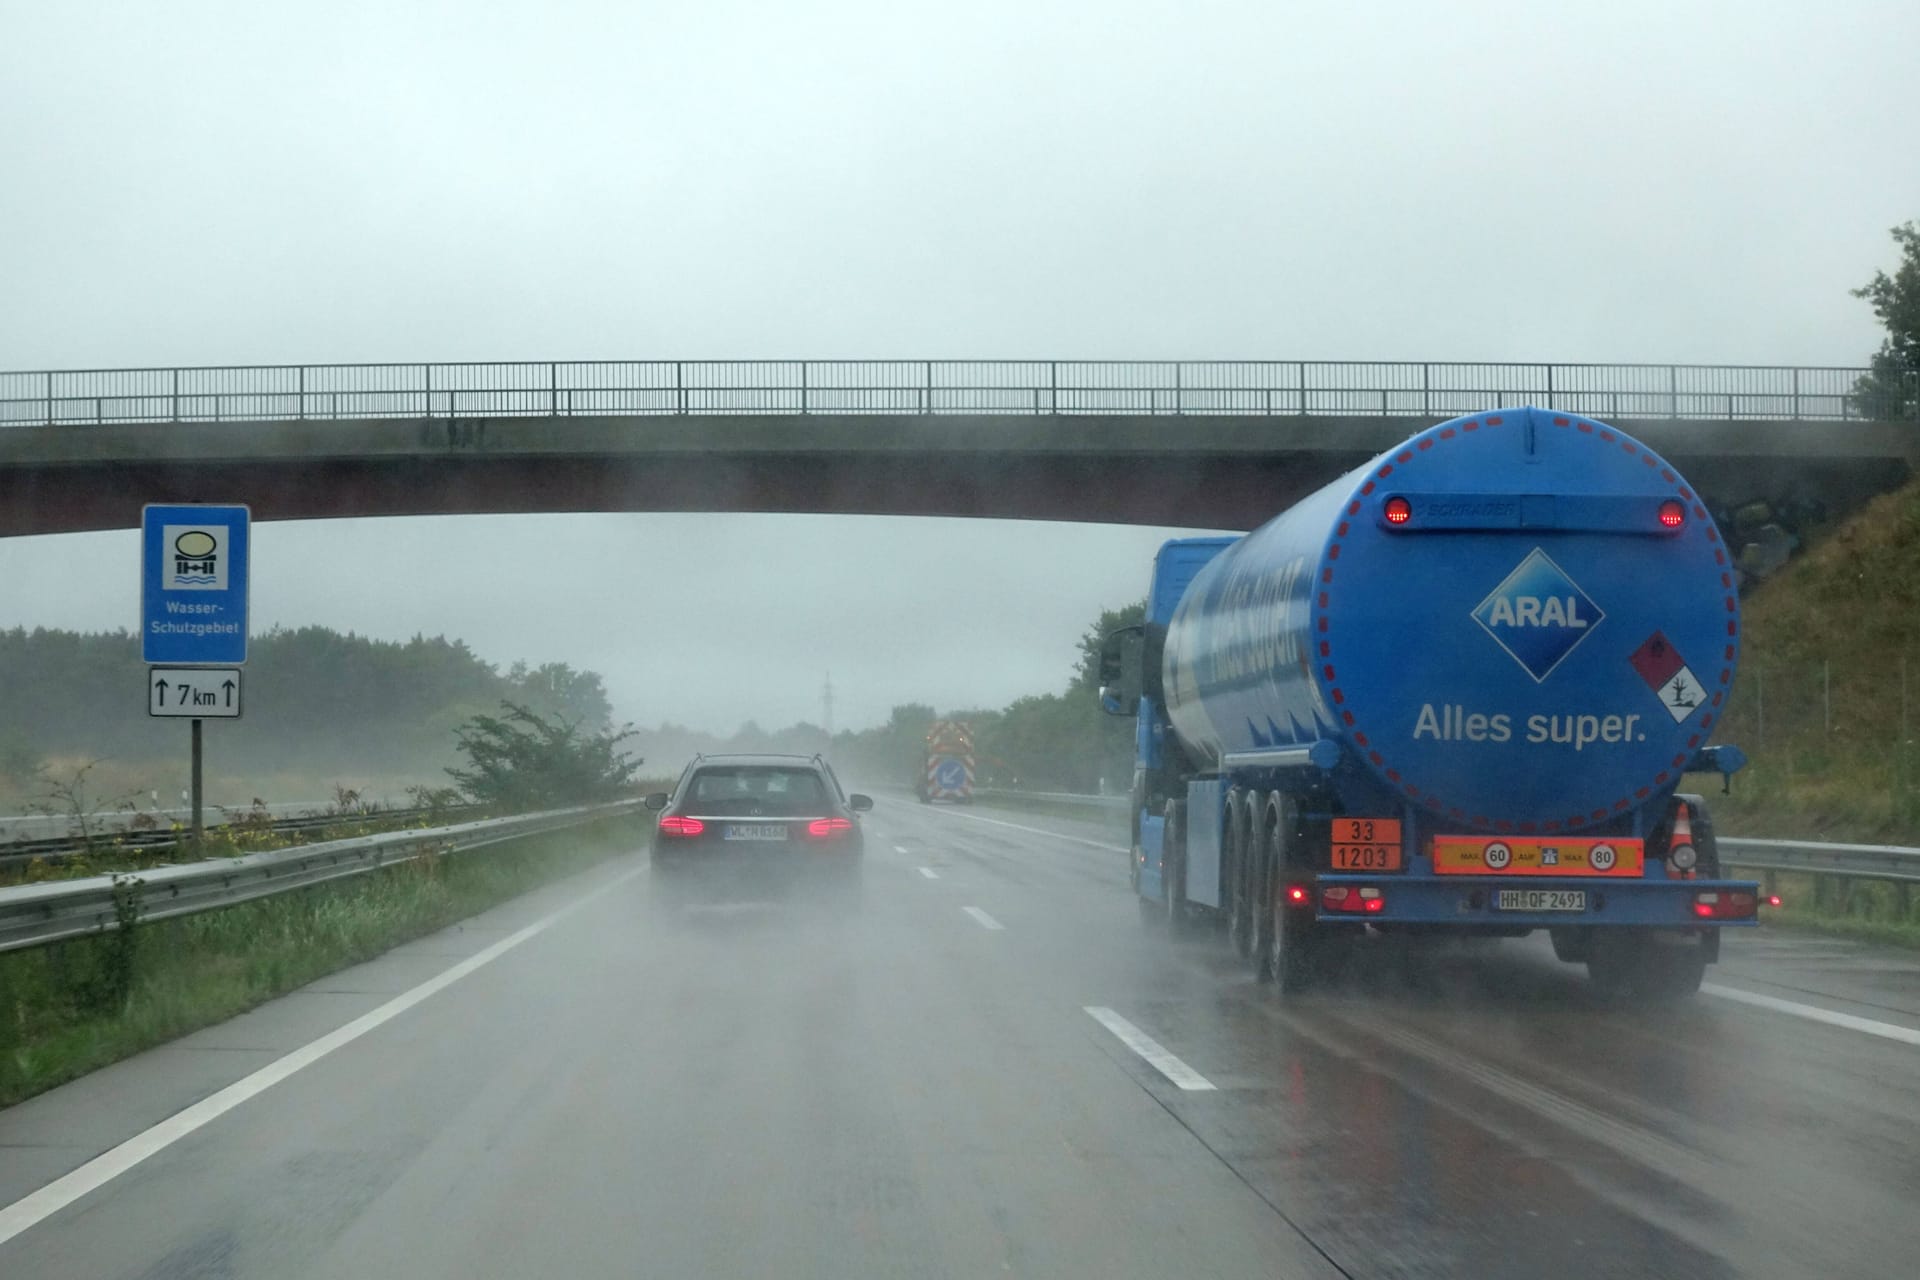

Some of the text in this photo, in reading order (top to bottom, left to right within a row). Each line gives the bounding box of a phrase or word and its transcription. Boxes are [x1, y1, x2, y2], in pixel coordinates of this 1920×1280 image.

[166, 601, 224, 614] Wasser-
[1489, 595, 1587, 628] ARAL
[151, 620, 239, 636] Schutzgebiet
[178, 684, 216, 706] 7 km
[1413, 702, 1646, 752] Alles super.
[1351, 820, 1374, 841] 33
[1339, 847, 1386, 867] 1203
[1489, 849, 1506, 862] 60
[1595, 851, 1611, 864] 80
[1501, 892, 1519, 908] HH
[1550, 892, 1584, 908] 2491
